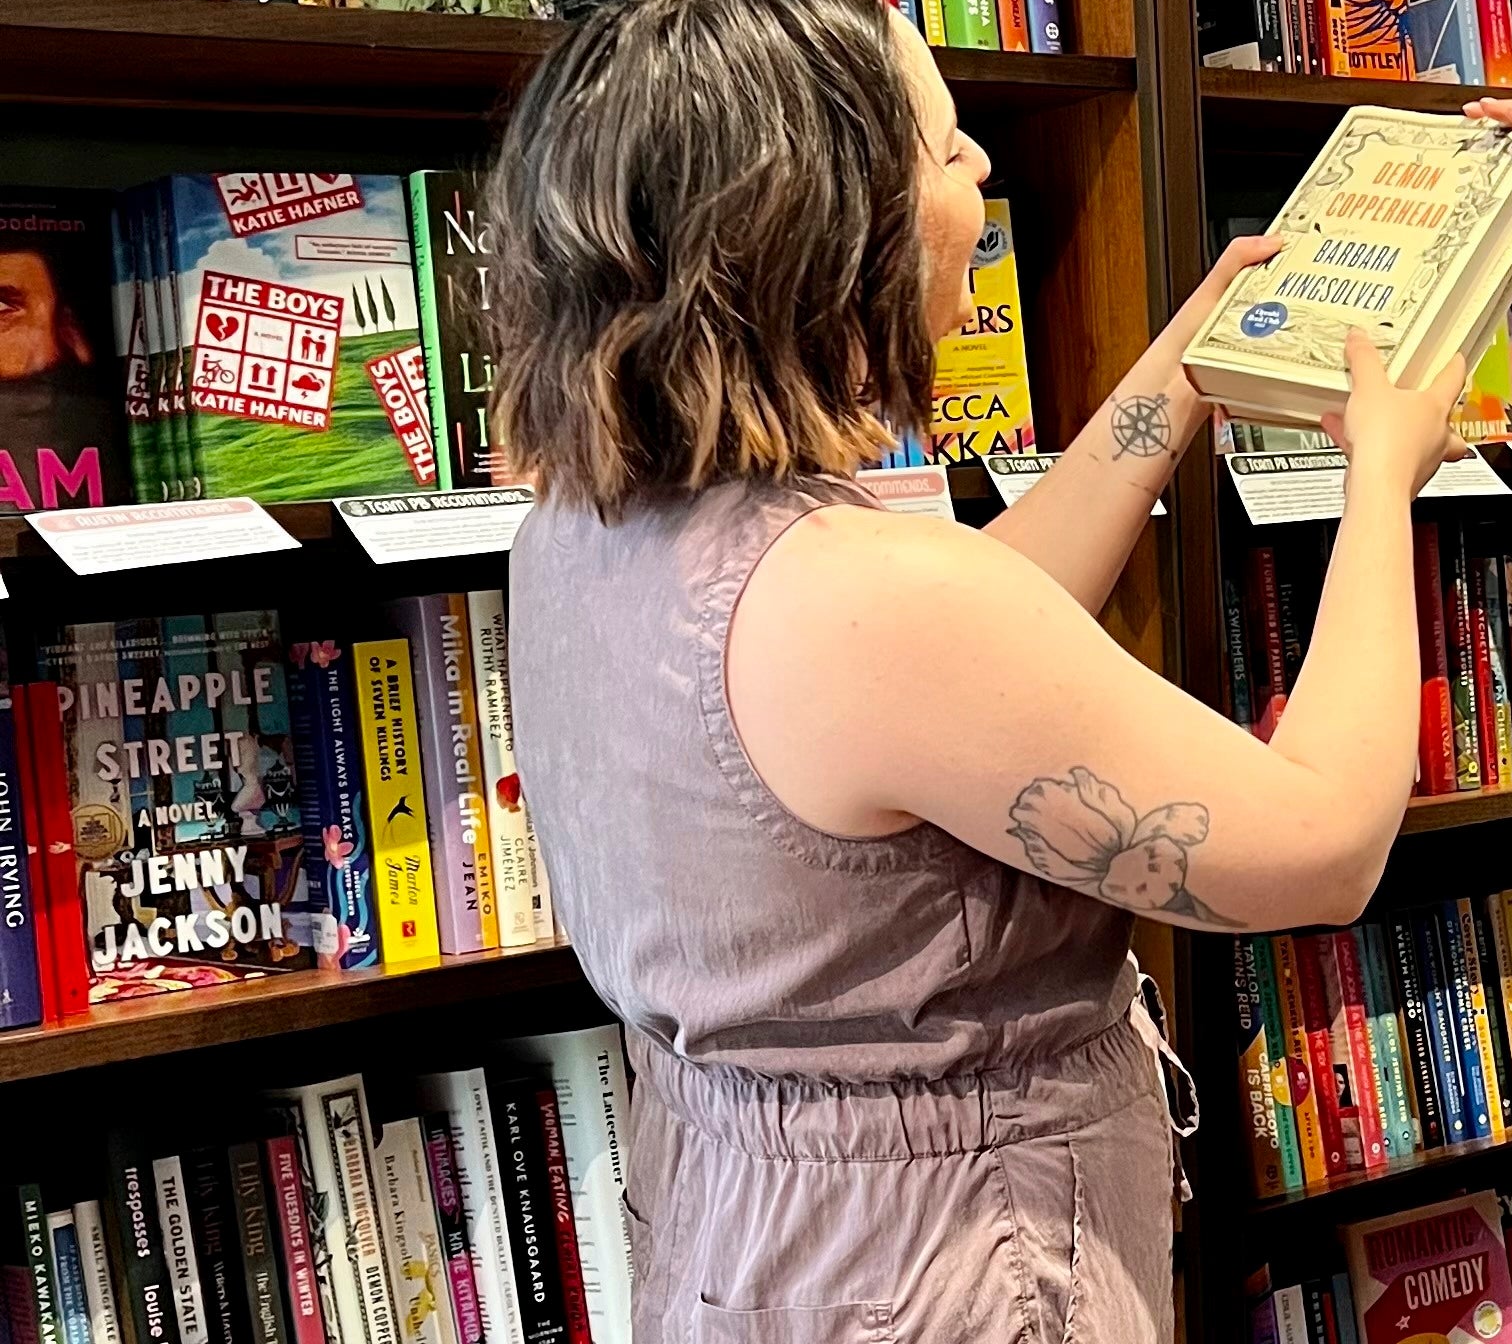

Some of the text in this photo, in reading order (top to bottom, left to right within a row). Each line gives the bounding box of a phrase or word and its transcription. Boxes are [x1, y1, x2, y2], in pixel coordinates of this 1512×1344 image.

[1373, 161, 1446, 191] DEMON
[231, 189, 361, 237] KATIE HAFNER
[1324, 191, 1448, 230] COPPERHEAD
[1312, 238, 1401, 271] BARBARA
[206, 275, 340, 322] THE BOYS
[1275, 271, 1395, 312] KINGSOLVER
[191, 390, 327, 428] KATIE HAFNER
[370, 358, 416, 431] BOYS
[401, 430, 434, 483] THE
[56, 666, 274, 723] PINEAPPLE
[95, 731, 245, 781] STREET
[440, 614, 477, 845] Mika in Real Life
[137, 801, 219, 828] A NOVEL
[121, 846, 248, 899] JENNY
[462, 861, 478, 911] JEAN
[478, 853, 493, 915] EMIKO
[93, 903, 284, 970] JACKSON
[1248, 1069, 1268, 1138] IS BACK
[24, 1199, 43, 1257] MIEKO
[124, 1166, 150, 1258] trespasses
[506, 1103, 546, 1304] KARL OVE KNAUSGAARD
[161, 1175, 198, 1336] THE GOLDEN STATE
[143, 1283, 162, 1339] louise
[1403, 1263, 1487, 1311] COMEDY
